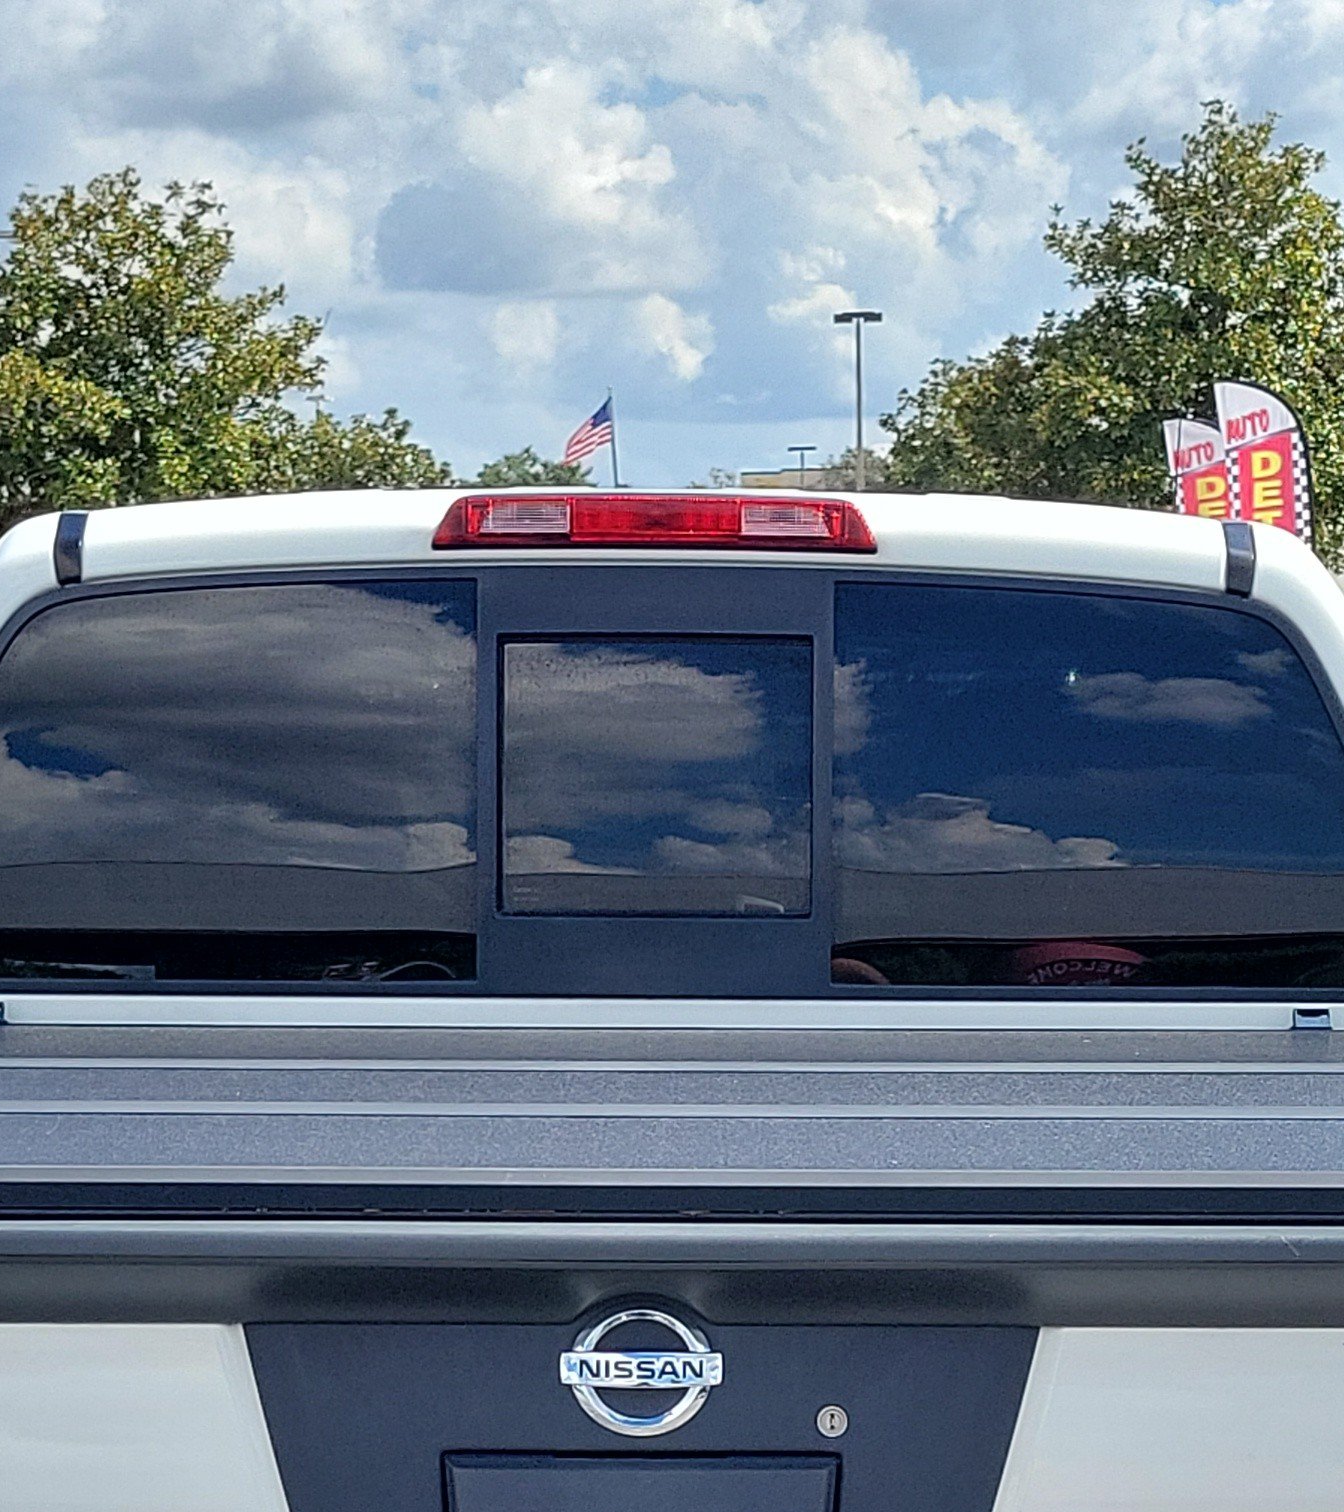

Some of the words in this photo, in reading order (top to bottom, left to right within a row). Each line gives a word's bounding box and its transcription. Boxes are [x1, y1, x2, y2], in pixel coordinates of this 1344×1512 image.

[1226, 408, 1269, 445] AUTO
[1173, 441, 1215, 469] AUTO
[578, 1358, 704, 1380] NISSAN
